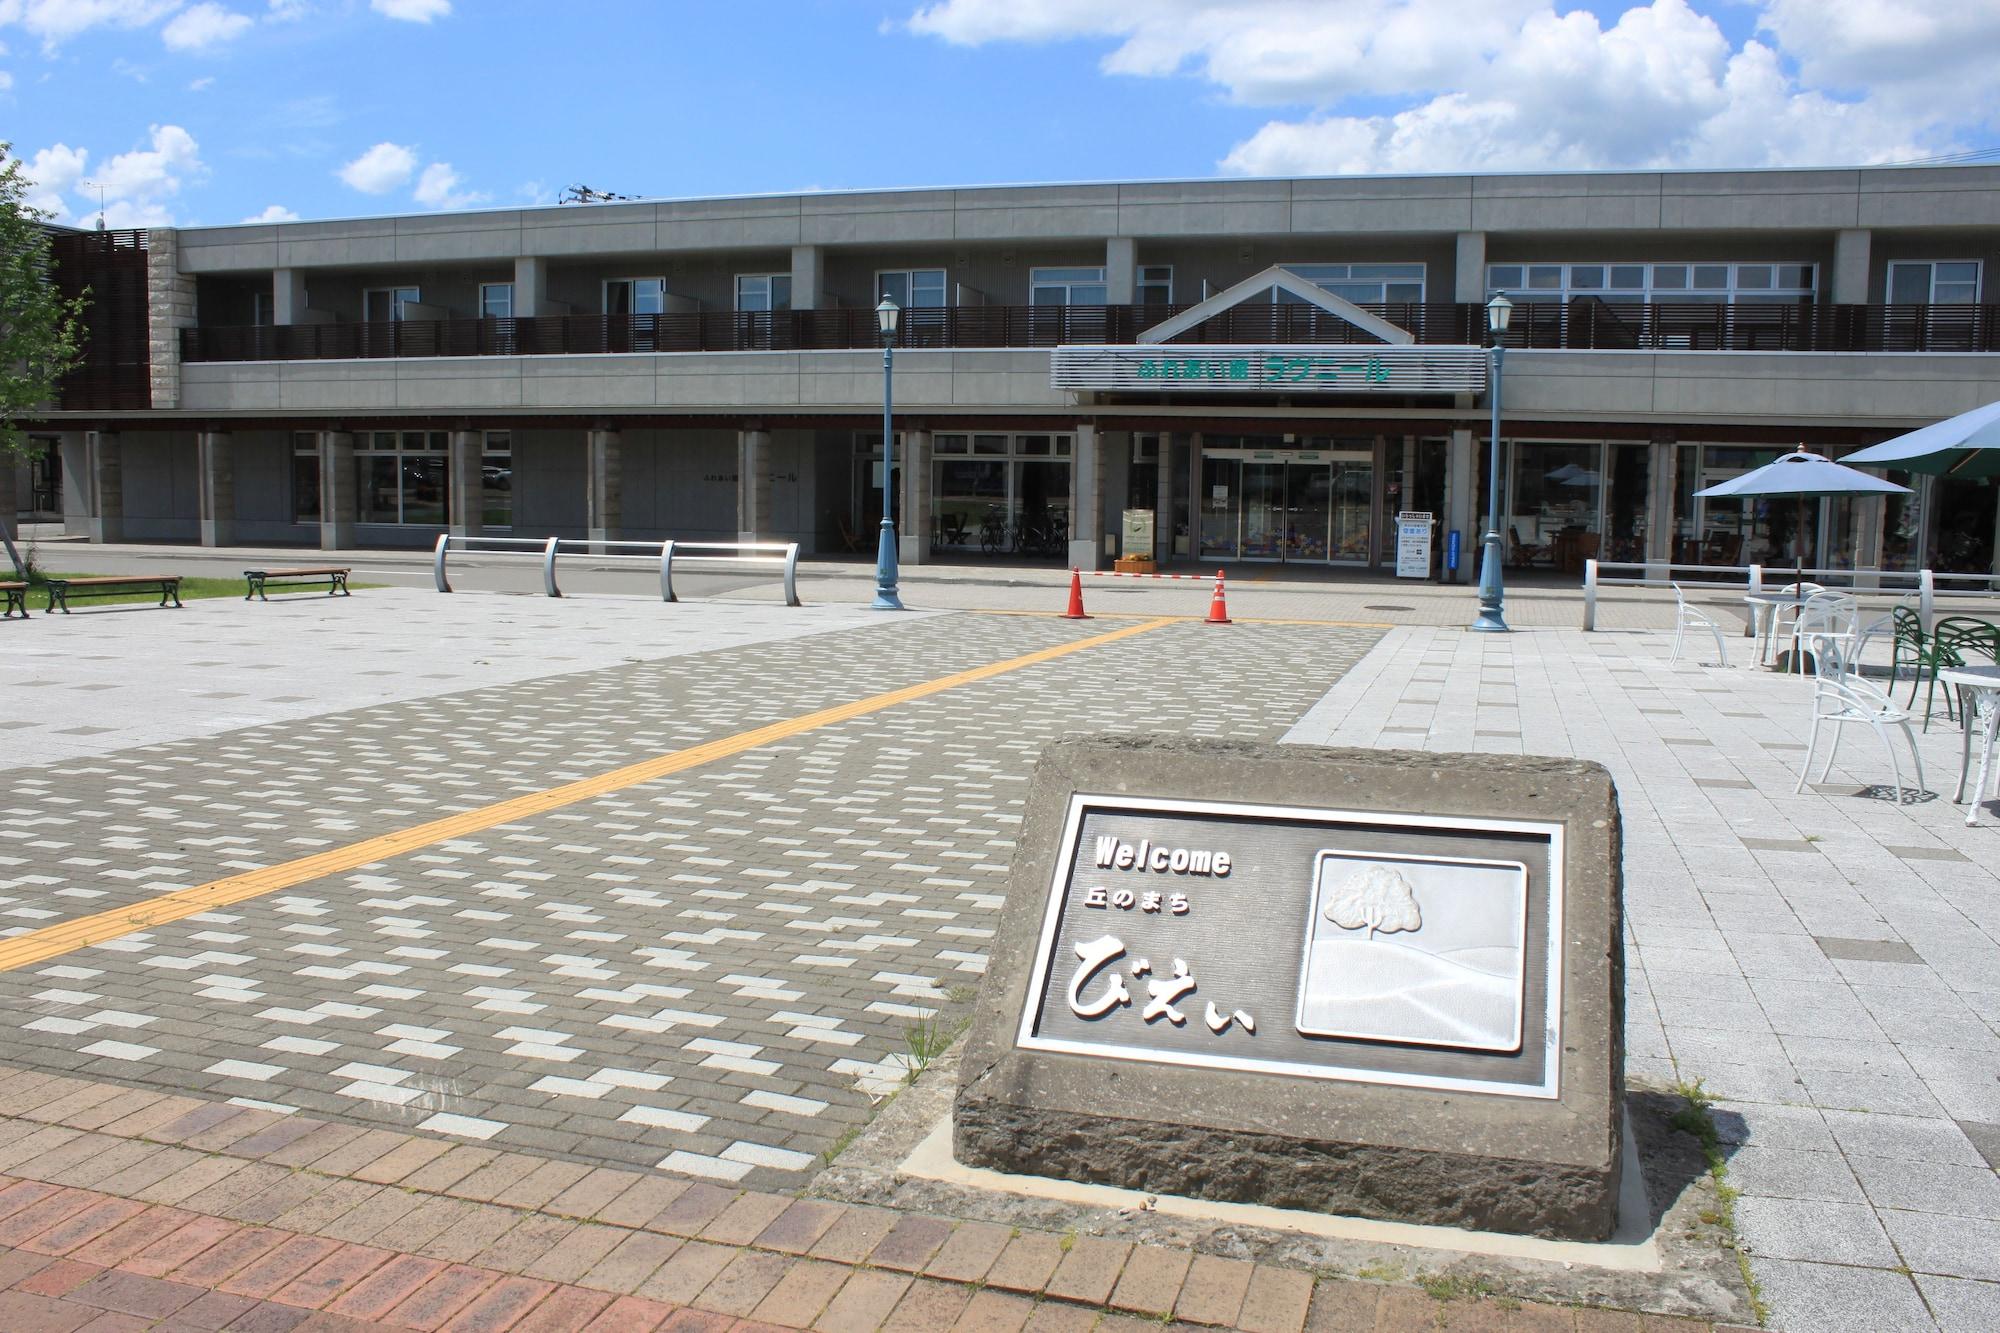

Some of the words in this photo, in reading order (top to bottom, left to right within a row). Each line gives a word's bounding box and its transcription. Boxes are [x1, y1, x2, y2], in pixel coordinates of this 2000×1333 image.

[1137, 359, 1249, 380] ふれあい館
[1096, 835, 1231, 876] Welcome
[1085, 886, 1189, 913] 丘のまち
[1068, 934, 1255, 1031] びえい
